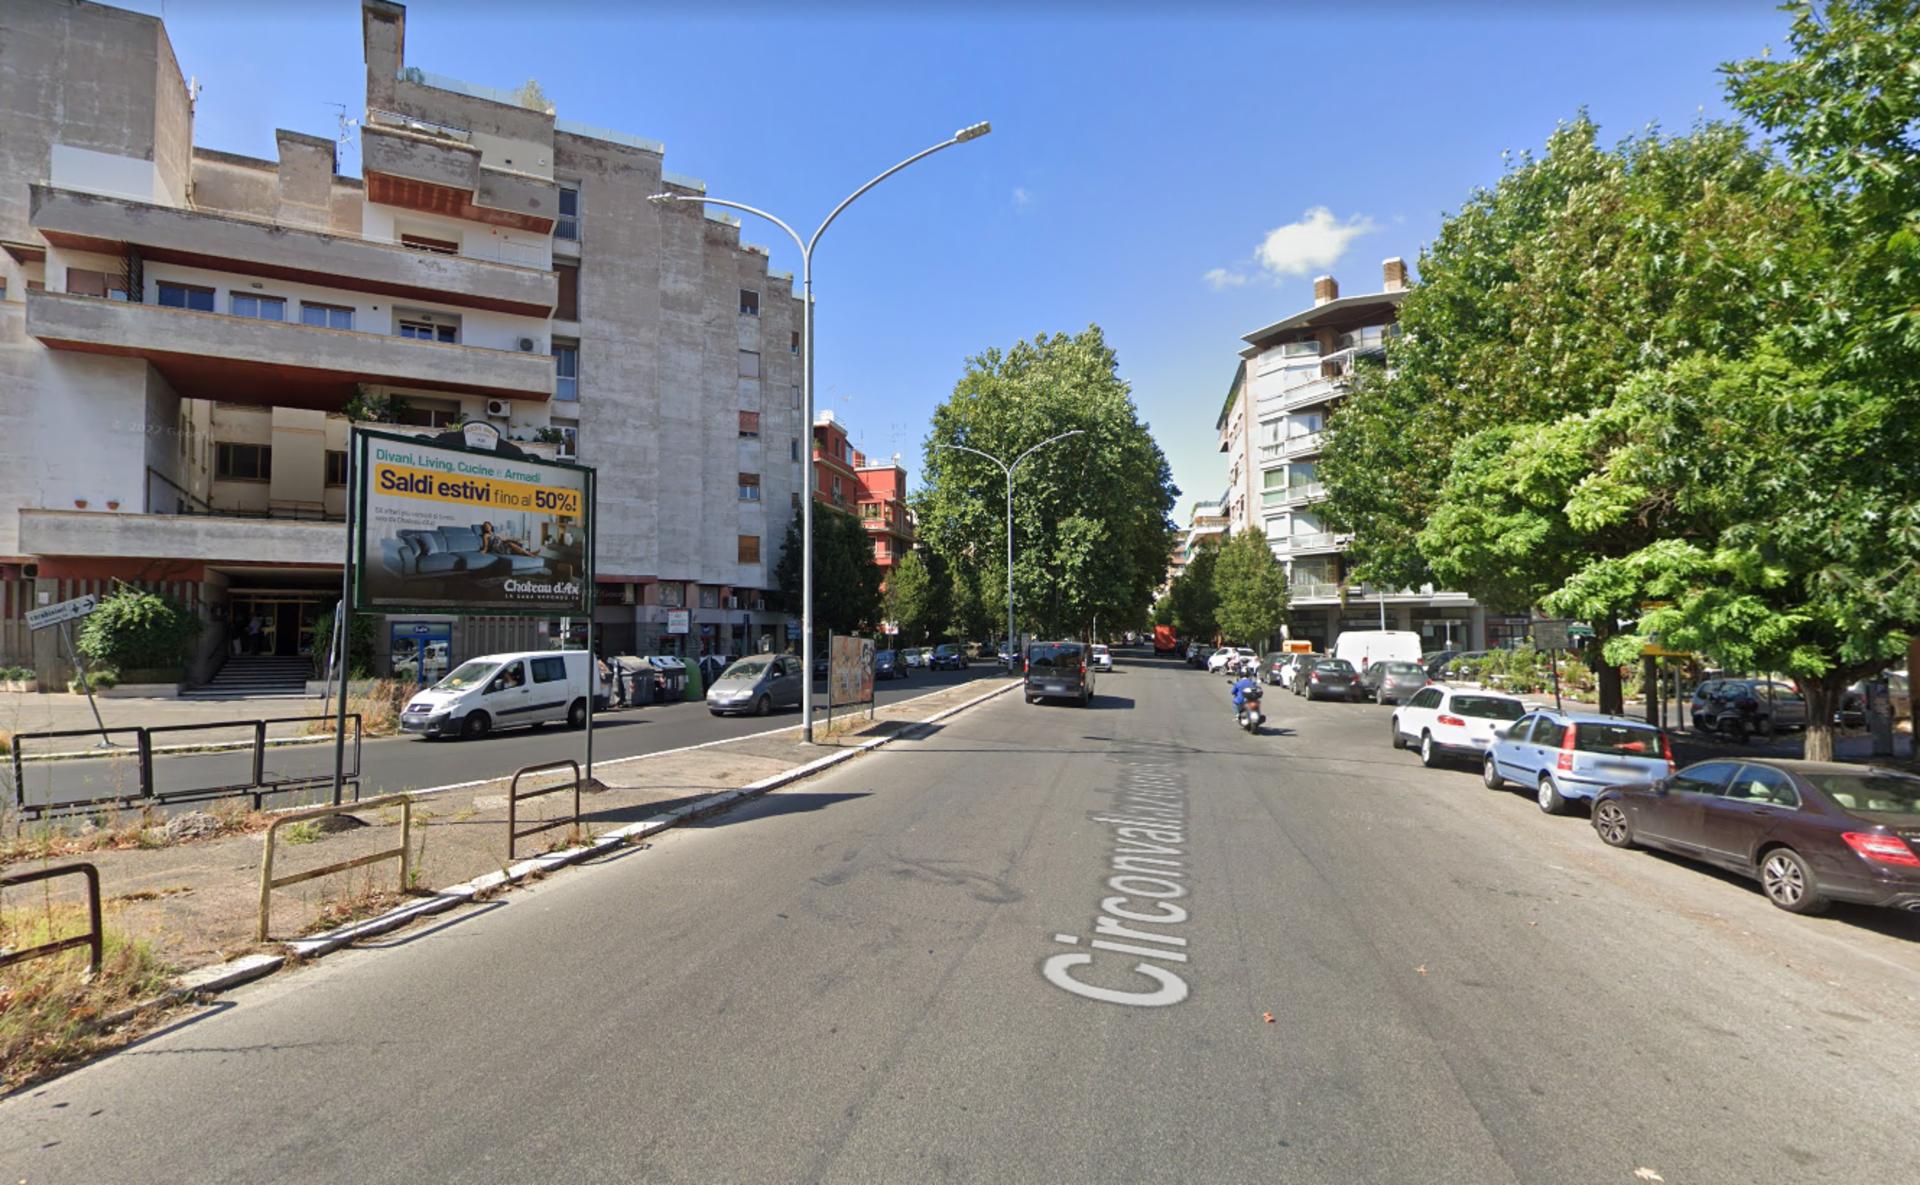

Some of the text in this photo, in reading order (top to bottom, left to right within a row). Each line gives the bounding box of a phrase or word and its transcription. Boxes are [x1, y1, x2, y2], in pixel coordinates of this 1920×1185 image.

[376, 448, 416, 466] Divani,
[418, 455, 455, 473] Living,
[457, 461, 495, 477] Cucine
[504, 469, 541, 483] Armadi
[380, 469, 577, 513] Saldi estivi fino al 50%!
[503, 579, 552, 594] Chateau
